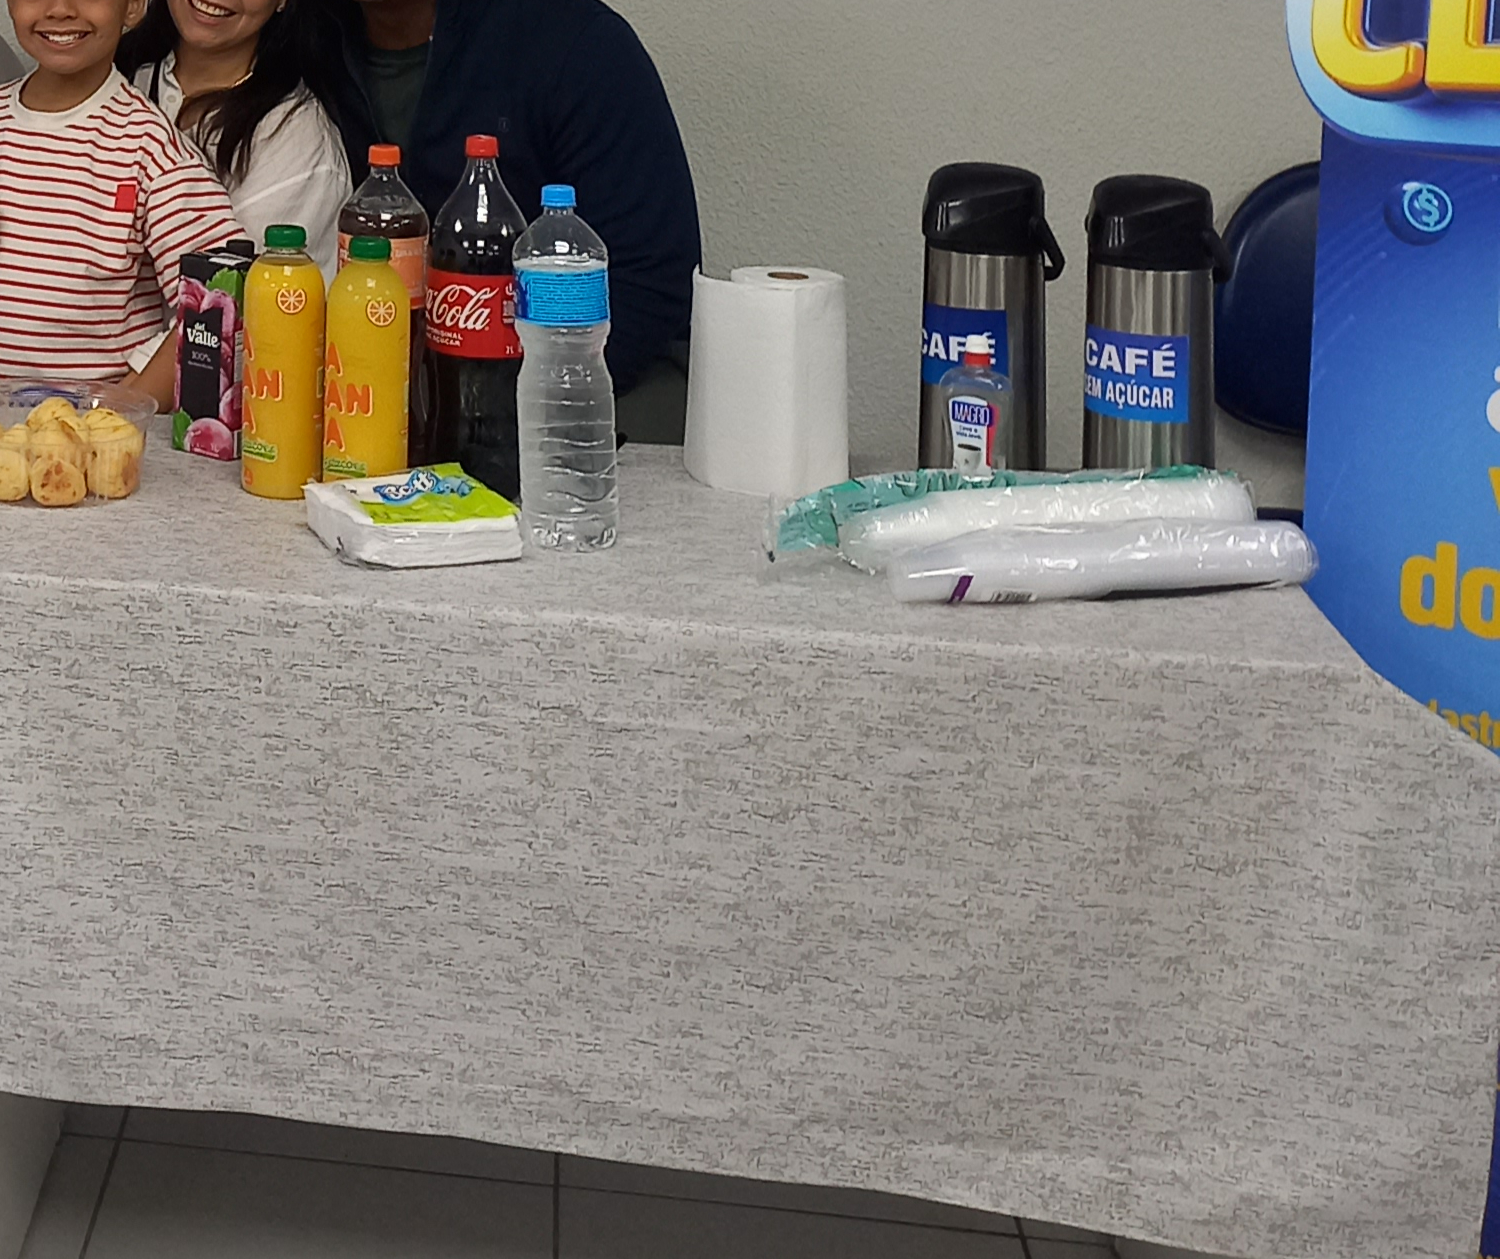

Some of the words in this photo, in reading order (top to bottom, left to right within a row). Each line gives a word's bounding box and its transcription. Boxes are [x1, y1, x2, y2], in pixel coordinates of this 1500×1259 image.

[186, 327, 220, 348] Valle
[1086, 338, 1176, 378] CAFÉ
[1085, 373, 1101, 399] EM
[1105, 379, 1174, 410] AÇÚCAR
